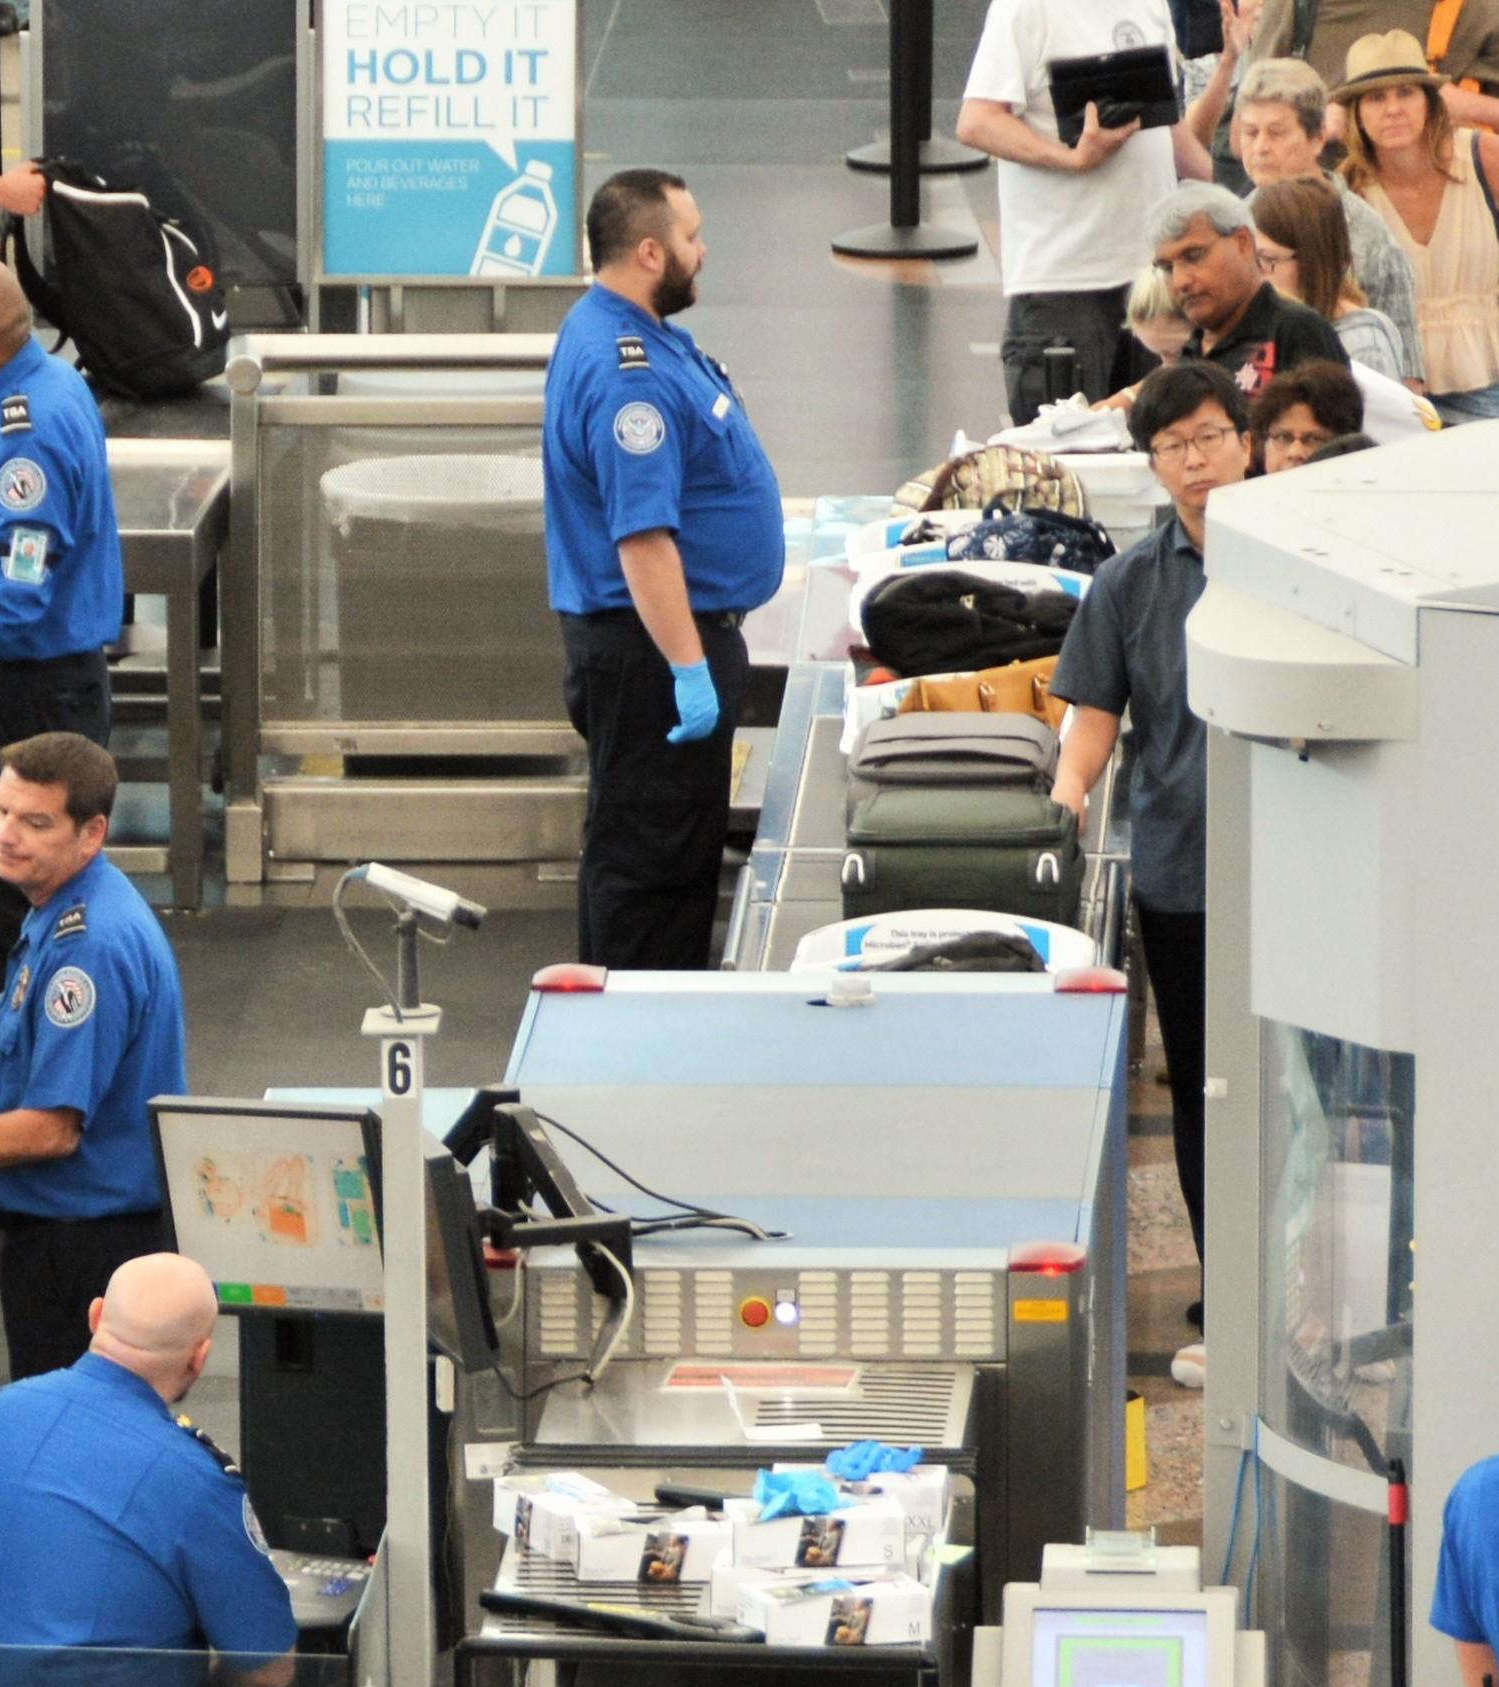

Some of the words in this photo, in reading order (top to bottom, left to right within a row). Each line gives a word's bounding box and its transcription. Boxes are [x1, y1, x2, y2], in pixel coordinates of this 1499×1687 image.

[346, 3, 497, 38] EMPTY
[513, 4, 550, 38] IT
[347, 49, 487, 84] HOLD
[505, 49, 549, 84] IT
[347, 95, 496, 128] REFILL
[512, 95, 550, 128] IT
[346, 159, 388, 171] POUR
[392, 159, 423, 171] OUT
[427, 159, 480, 171] WATER
[346, 176, 378, 189] AND
[381, 176, 468, 189] BEVERAGES
[346, 194, 386, 207] HERE
[387, 1041, 412, 1095] 6
[883, 1544, 894, 1560] S
[908, 1620, 921, 1635] M
